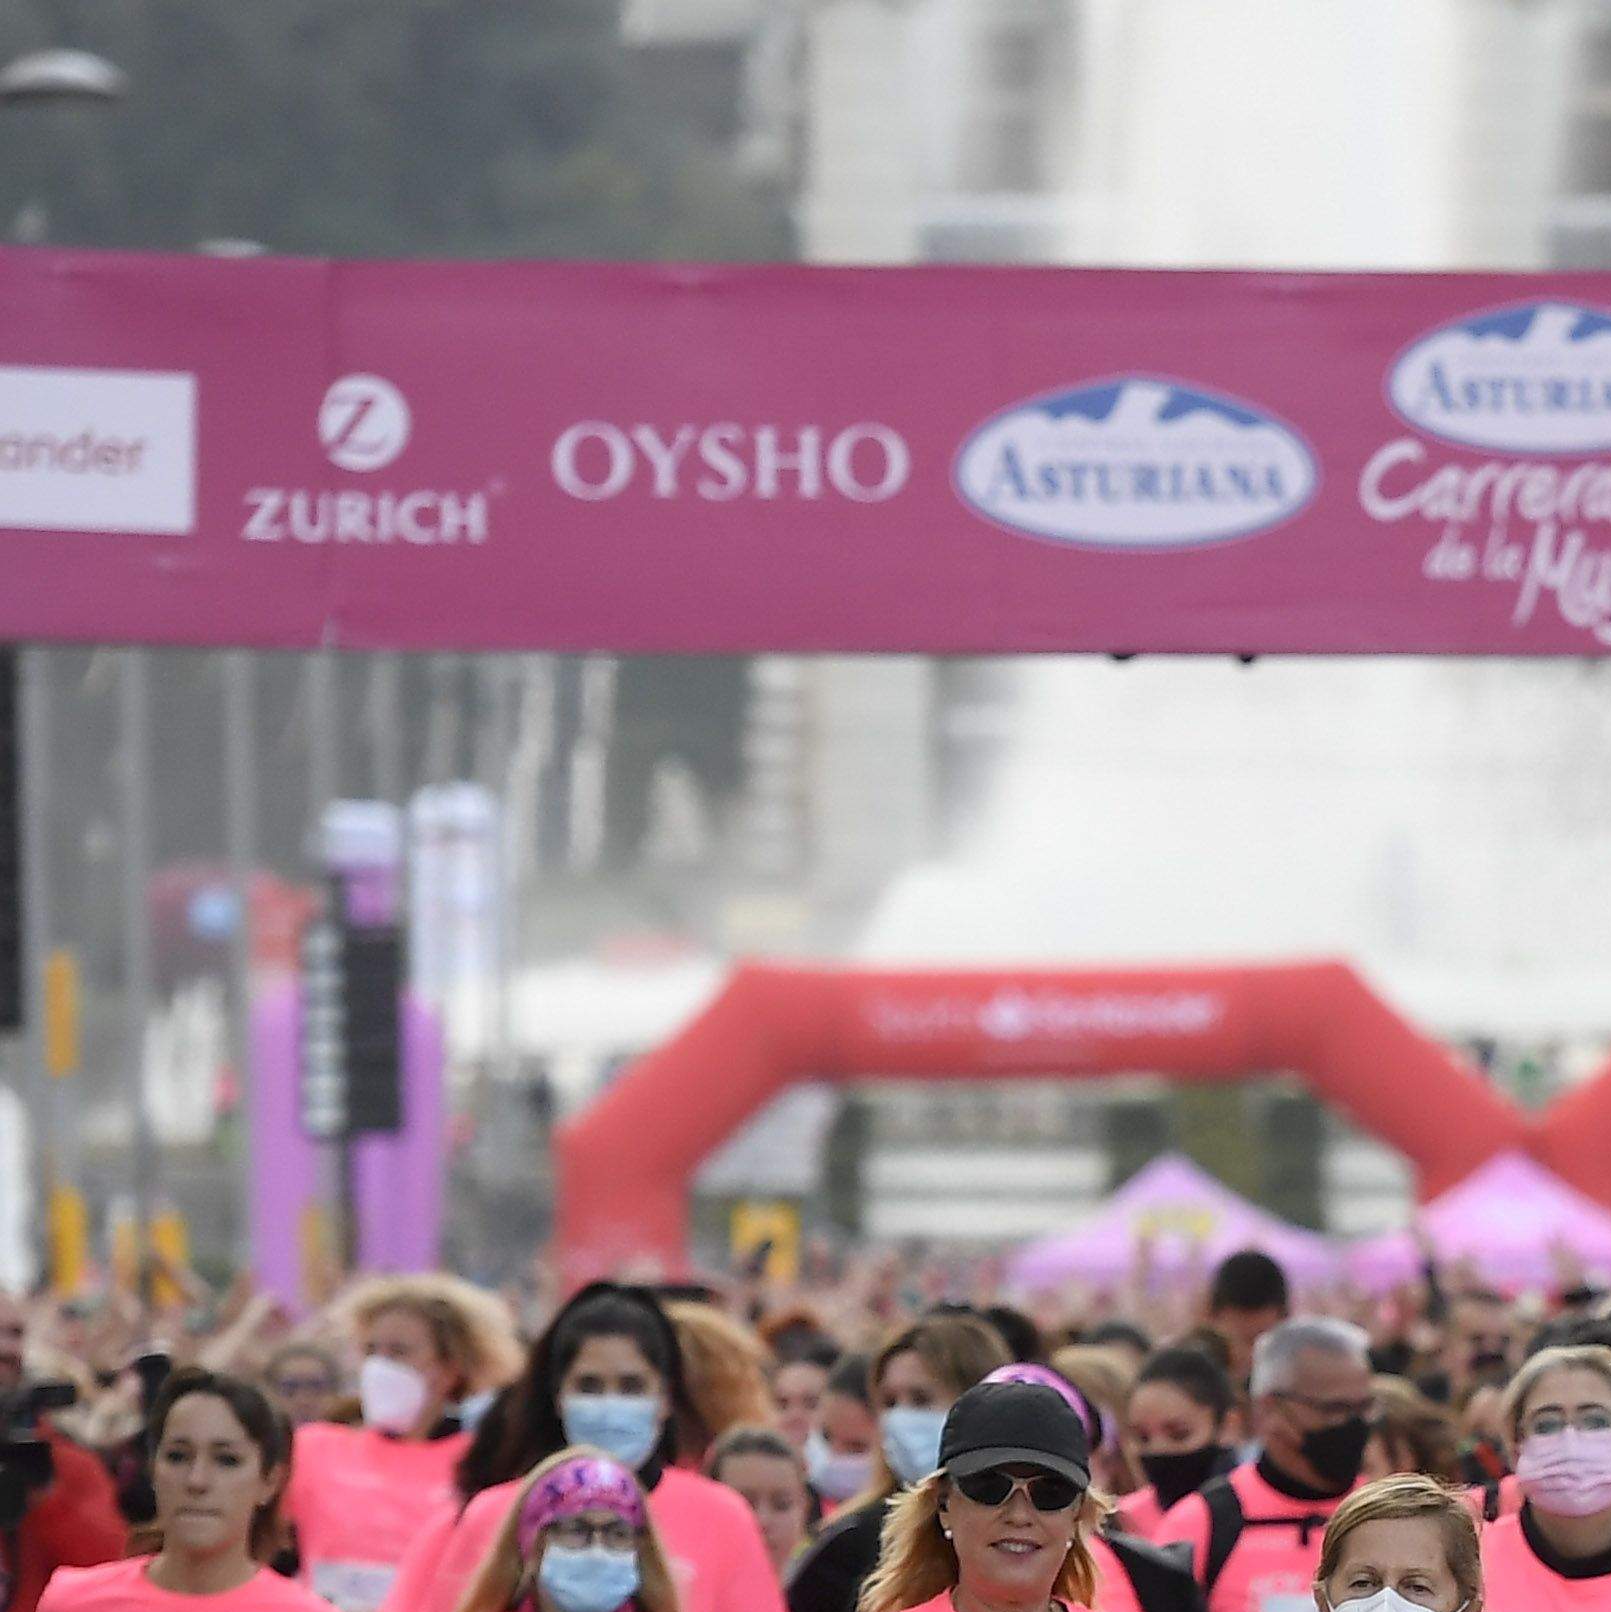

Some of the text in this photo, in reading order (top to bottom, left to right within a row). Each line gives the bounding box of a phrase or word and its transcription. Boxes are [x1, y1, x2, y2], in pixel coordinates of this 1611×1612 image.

[0, 433, 147, 476] ander
[552, 421, 911, 502] OYSHO
[990, 446, 1288, 505] ASTURIANA
[241, 489, 489, 545] ZURICH
[1424, 533, 1475, 583] de
[1484, 537, 1526, 582] la
